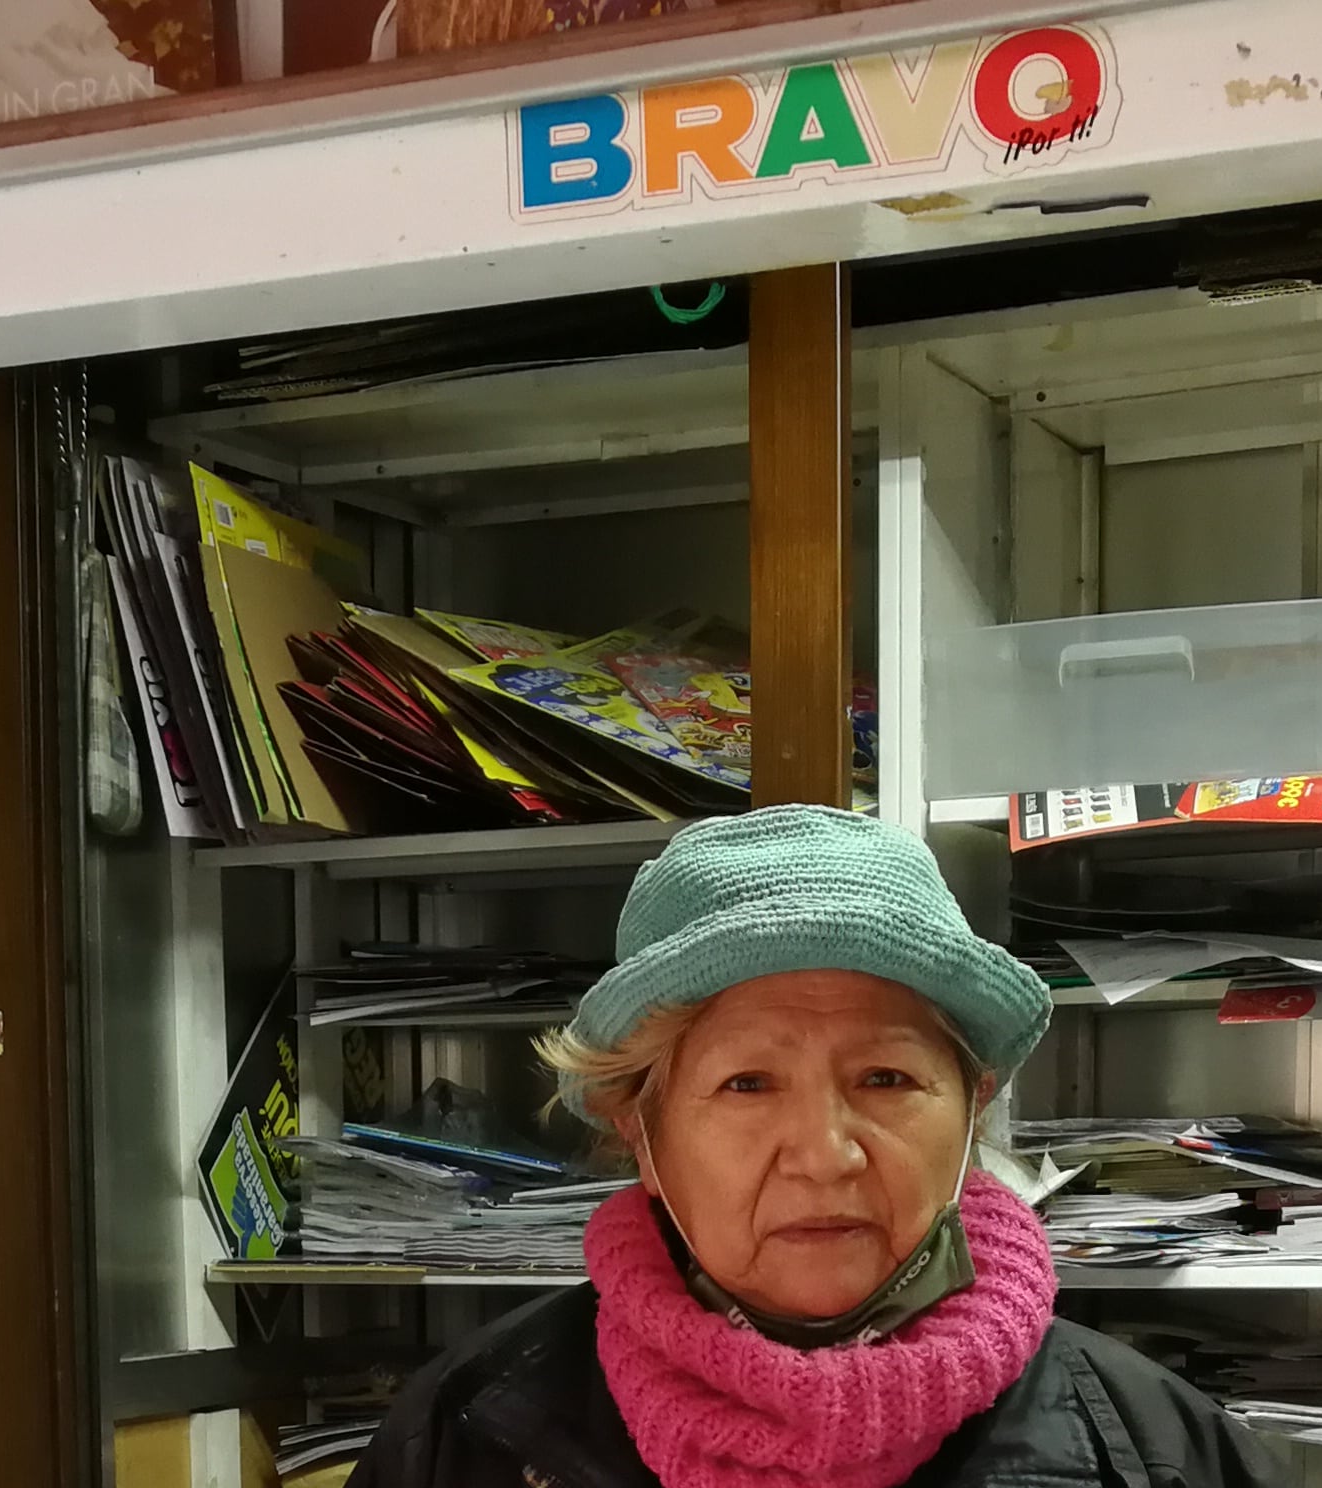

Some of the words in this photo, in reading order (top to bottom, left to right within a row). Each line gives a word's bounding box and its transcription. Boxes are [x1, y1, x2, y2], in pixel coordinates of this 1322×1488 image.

[50, 66, 156, 108] GRAN
[520, 26, 1101, 208] BRAVO
[234, 1153, 266, 1237] Reserva
